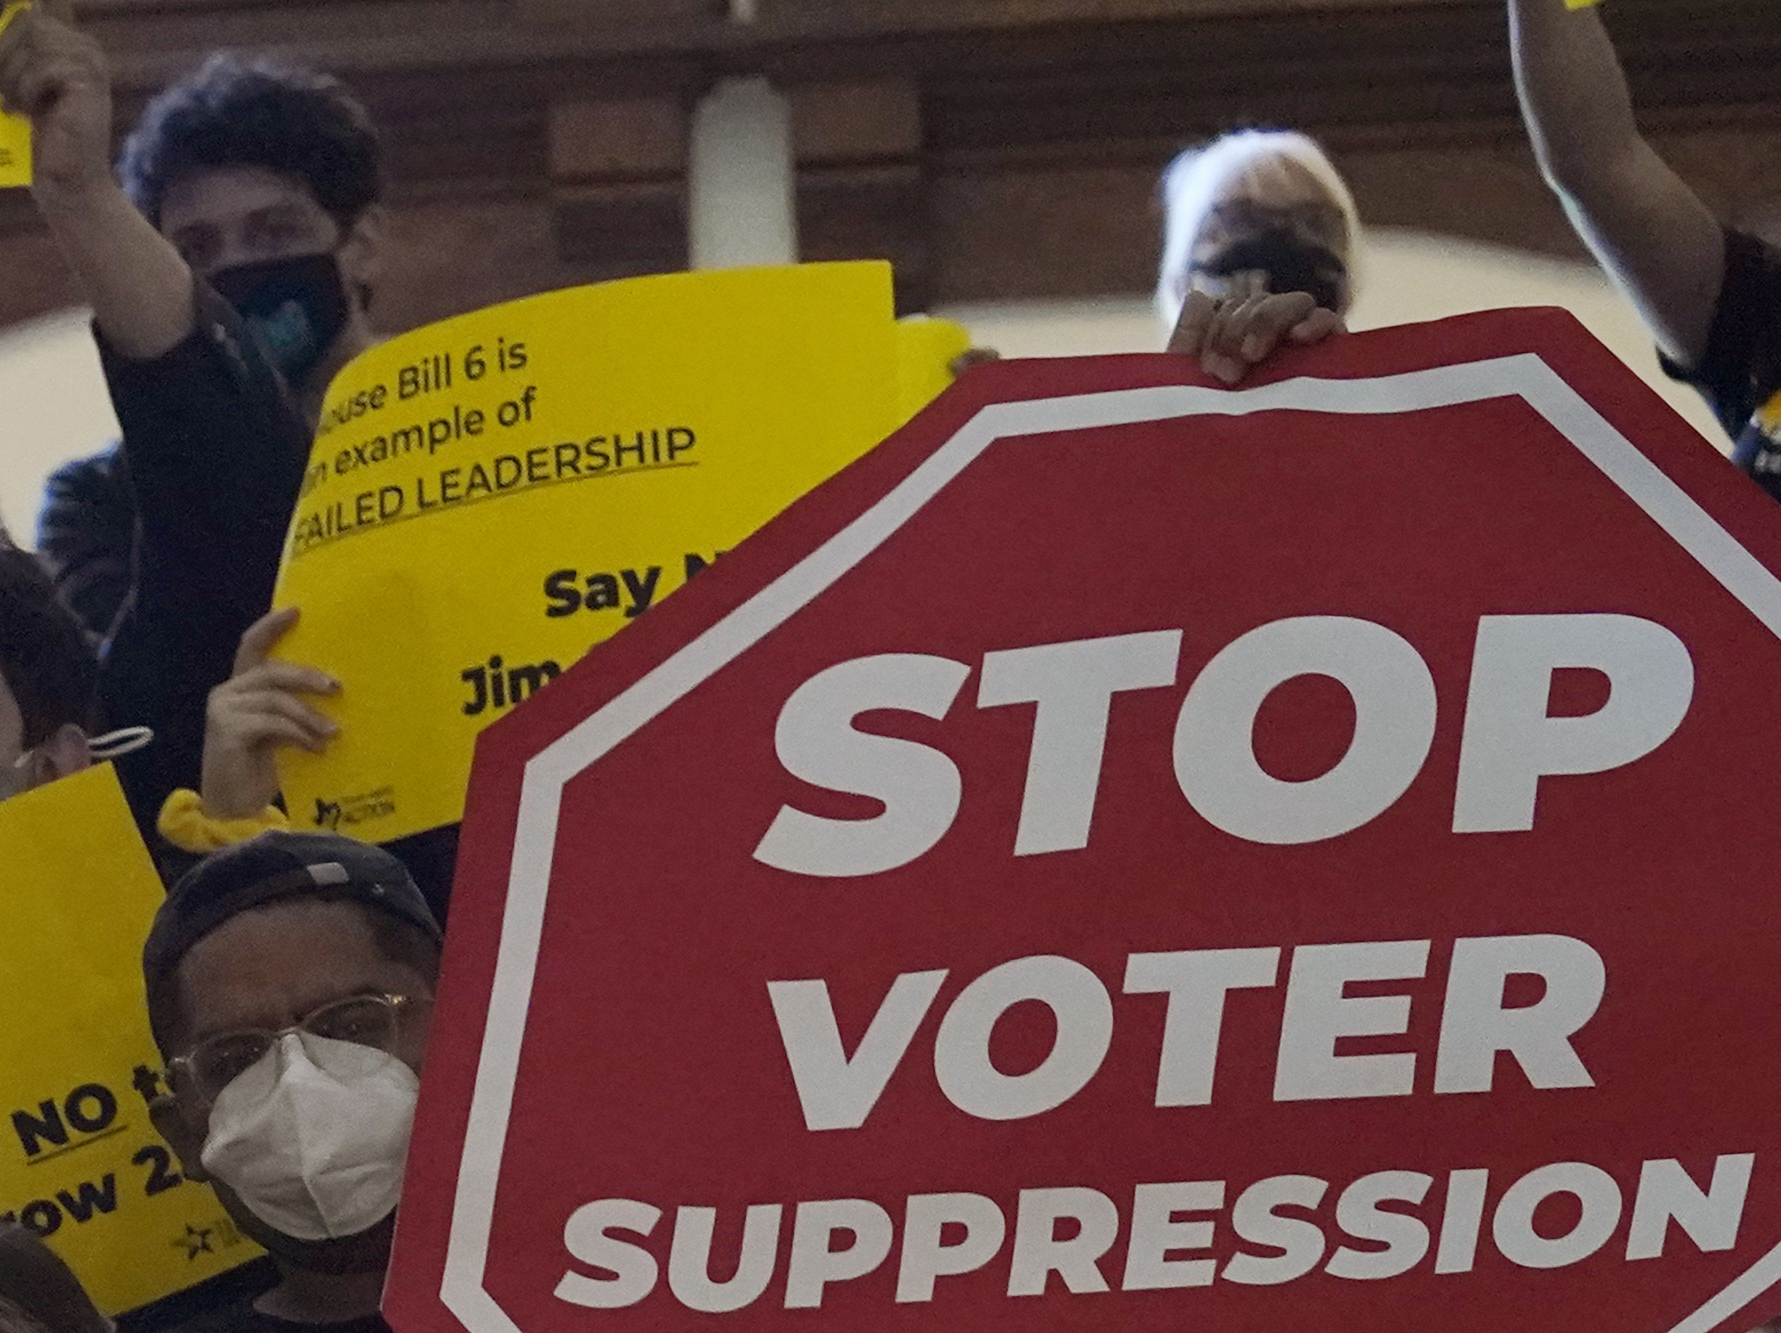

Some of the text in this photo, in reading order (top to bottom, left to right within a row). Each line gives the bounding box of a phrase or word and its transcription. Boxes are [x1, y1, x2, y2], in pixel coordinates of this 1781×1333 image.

[398, 353, 451, 400] Bill
[464, 346, 487, 381] 6
[497, 337, 528, 373] is
[335, 400, 486, 477] example
[498, 386, 539, 430] of
[417, 425, 698, 512] LEADERSHIP
[544, 565, 662, 619] Say
[750, 613, 1694, 877] STOP
[765, 934, 1606, 1132] VOTER
[10, 1083, 118, 1157] NO
[553, 1152, 1754, 1313] SUPPRESSION
